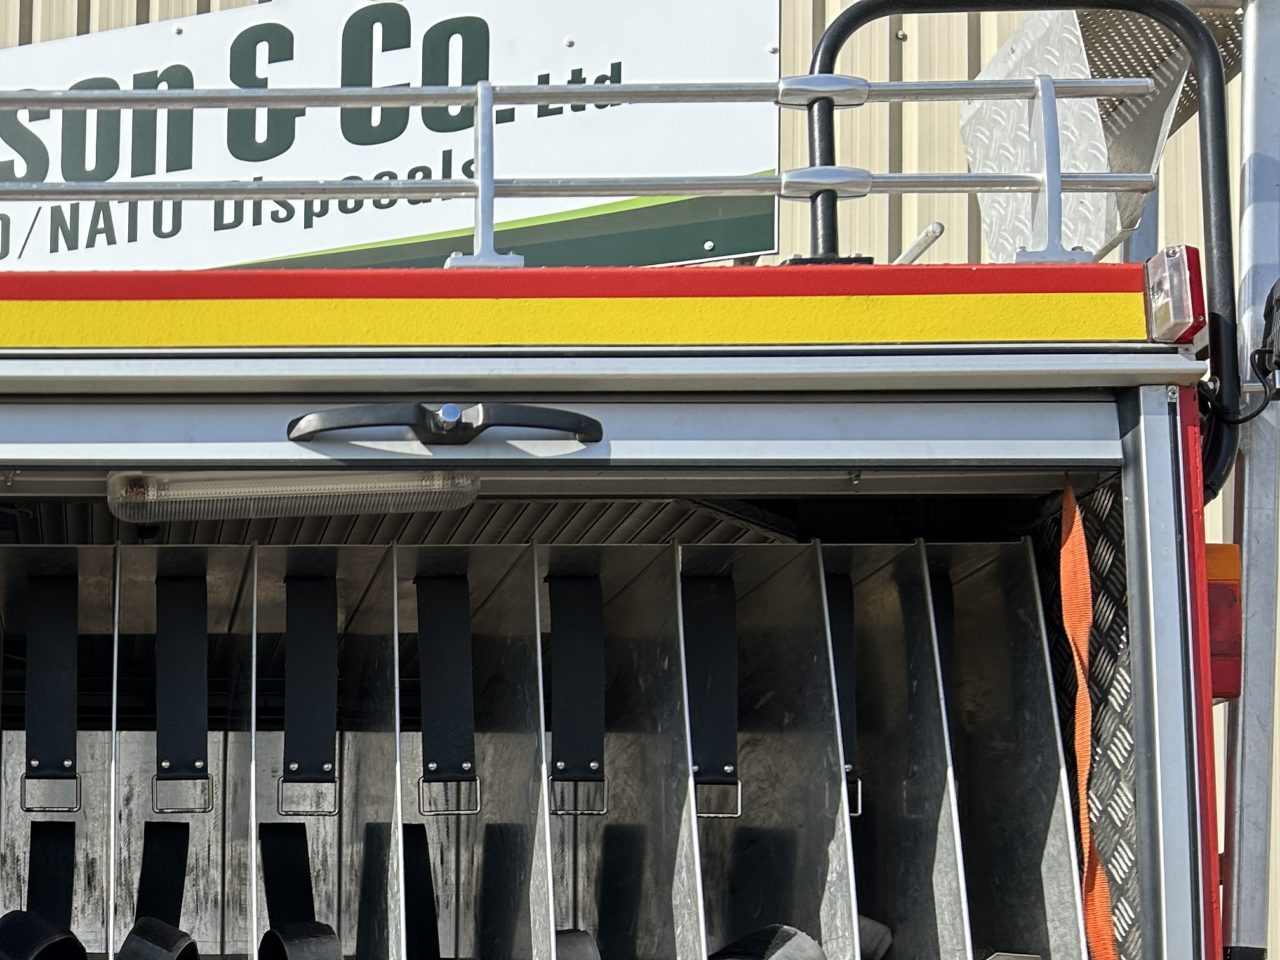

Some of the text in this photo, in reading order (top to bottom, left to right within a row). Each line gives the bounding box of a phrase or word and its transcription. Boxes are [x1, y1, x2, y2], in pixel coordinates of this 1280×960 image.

[226, 22, 307, 162] &
[339, 2, 516, 146] Co.
[213, 148, 478, 232] Disposal
